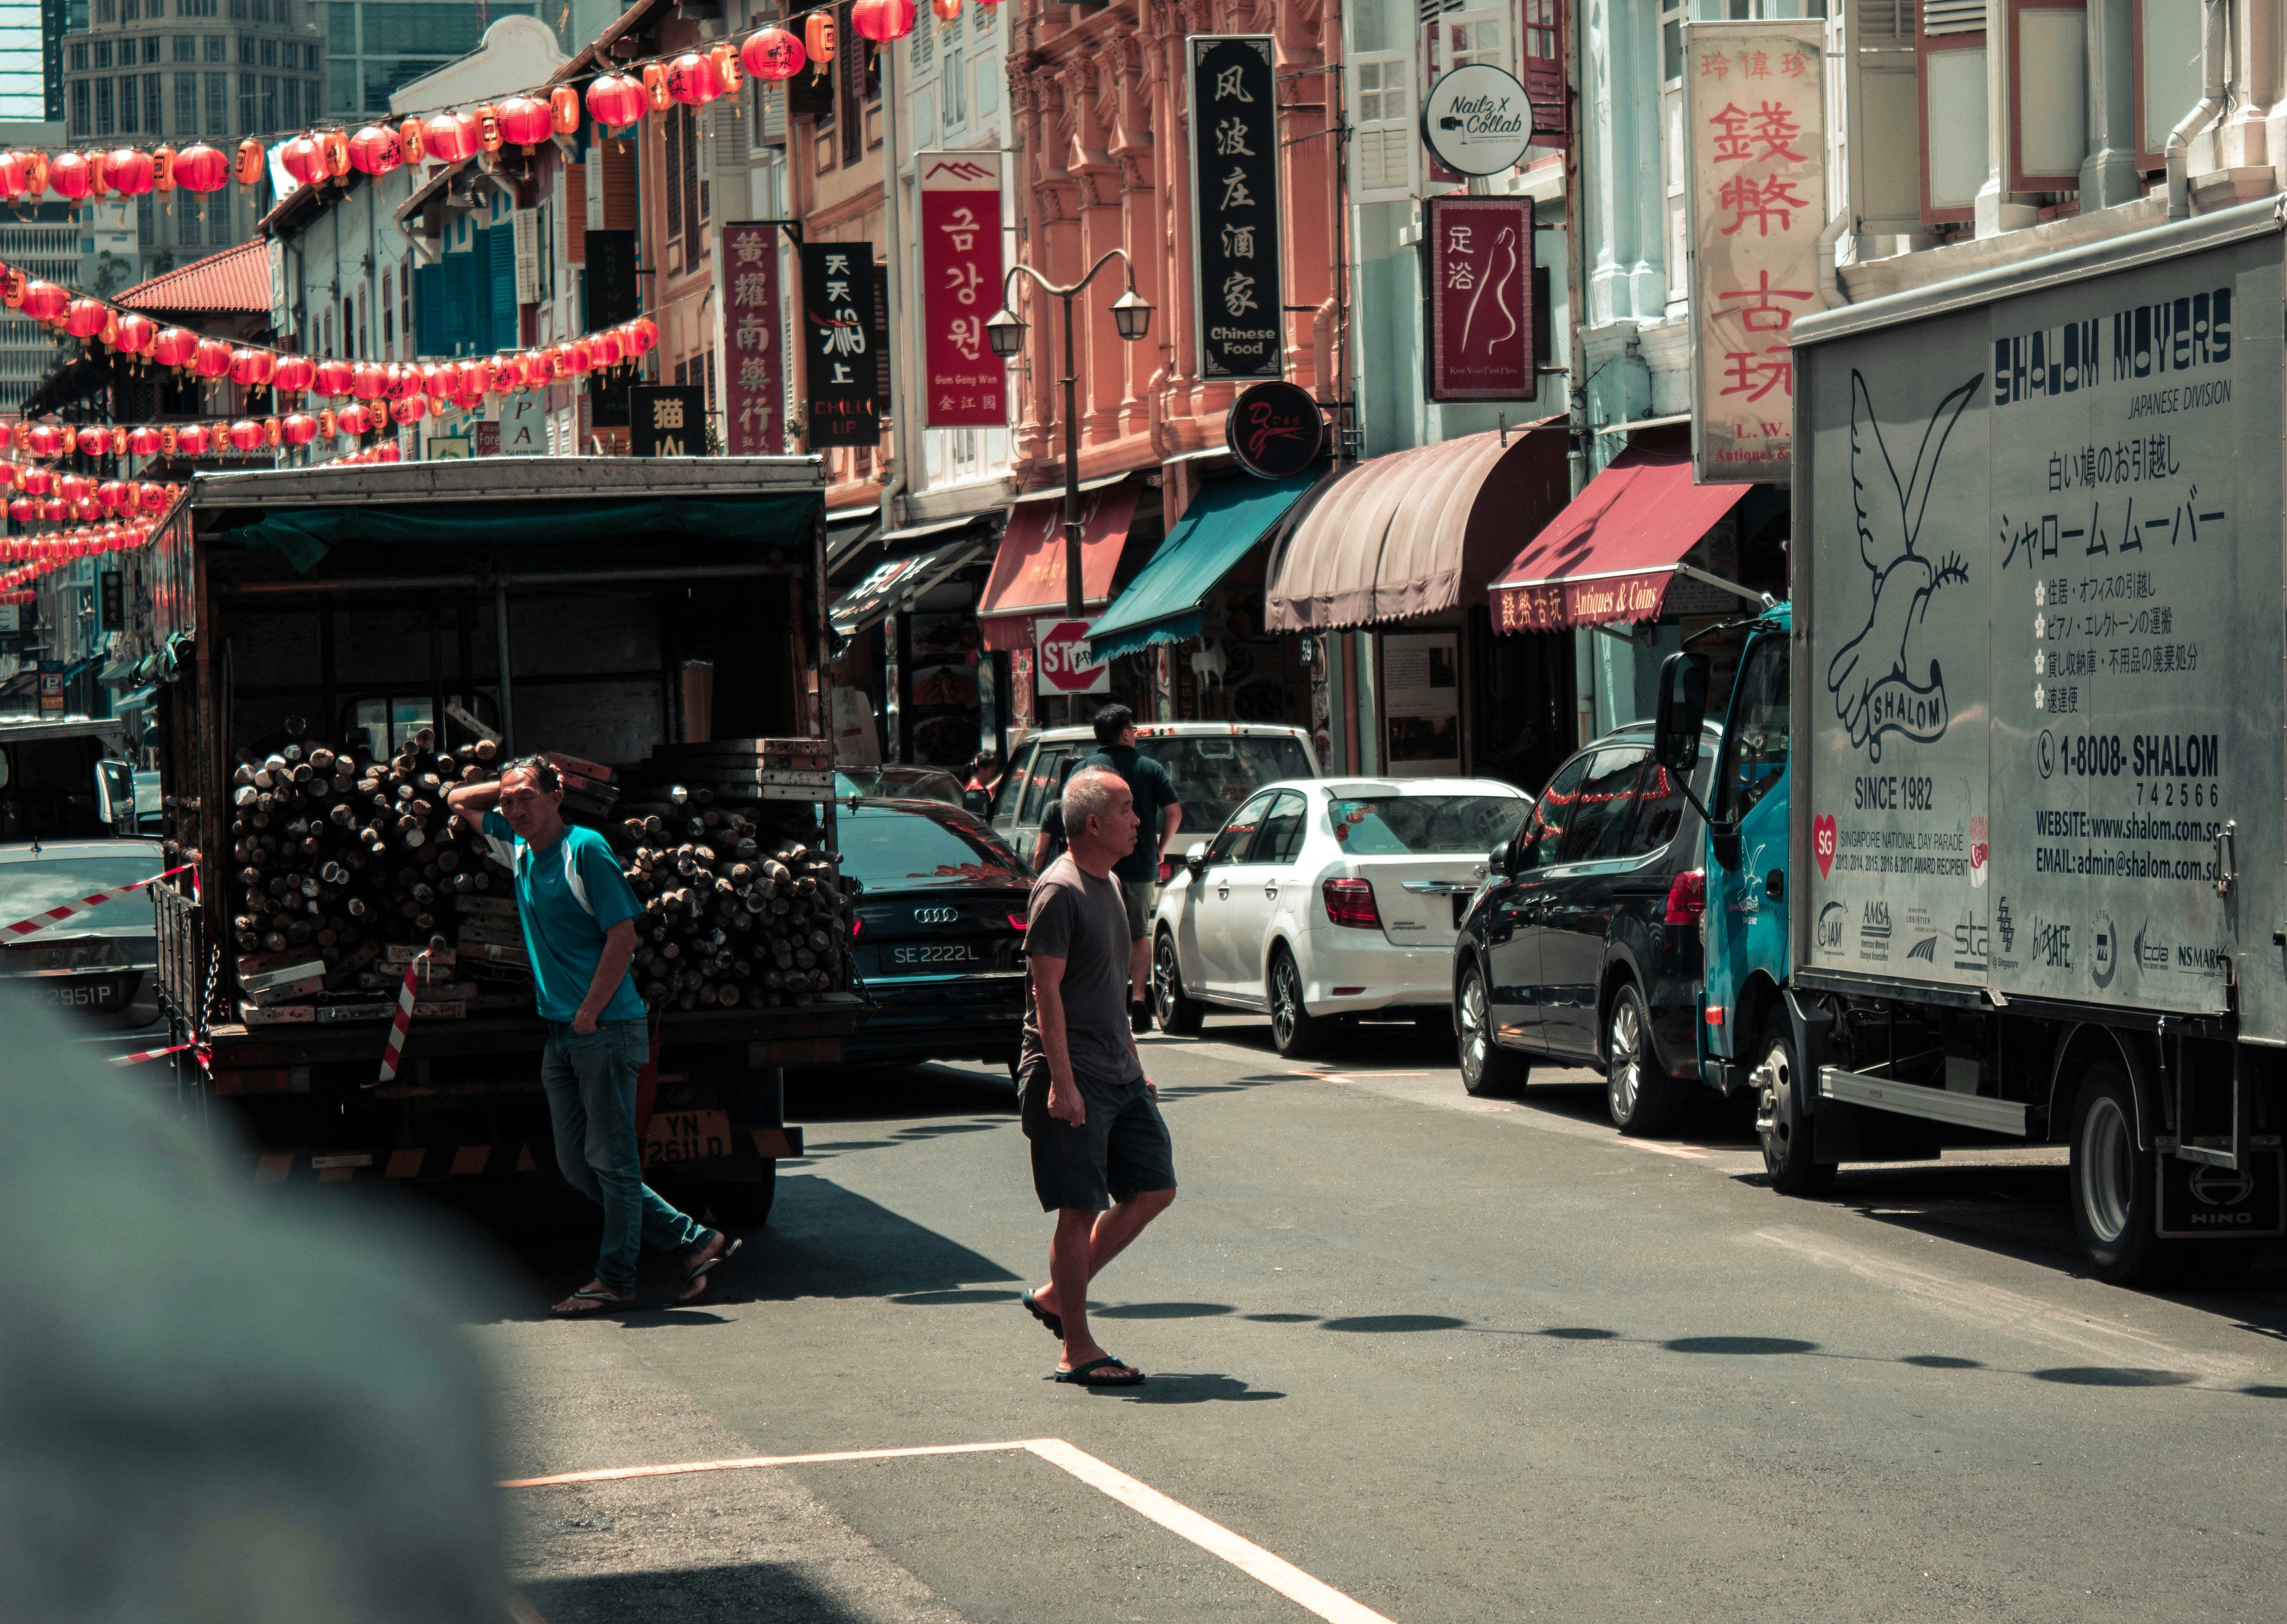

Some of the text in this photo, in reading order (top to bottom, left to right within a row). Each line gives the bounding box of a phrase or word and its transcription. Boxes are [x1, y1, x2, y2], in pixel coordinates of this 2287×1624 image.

[1450, 95, 1510, 121] Nailz X
[1467, 113, 1522, 133] Collab
[1215, 65, 1259, 318] 风波庄酒家
[1447, 226, 1475, 290] 足浴
[941, 207, 984, 361] 금강원
[1211, 327, 1276, 355] Chinese Food
[1995, 318, 2099, 406] SHALOM
[936, 375, 997, 386] Gum Gang Won
[939, 395, 996, 411] 金江园
[2129, 379, 2232, 420] JAPANESE DIVISION
[833, 421, 857, 435] UP
[1716, 446, 1788, 464] Antiques &
[2049, 432, 2180, 494] 白い鳩のお引越し
[2000, 484, 2225, 571] シャローム ムーバー
[1574, 584, 1614, 621] Antiques
[1616, 583, 1626, 612] &
[1629, 581, 1658, 611] Coins
[2047, 570, 2156, 607] 住居・オフィスの引越し
[2047, 605, 2172, 640] ピアノ・エレクトーンの運搬
[2047, 642, 2198, 679] 貸し収納庫・不用品の廃棄処分
[1873, 691, 1940, 731] SHALOM
[2047, 686, 2078, 714] 速達便
[2061, 734, 2218, 777] 1-8008- SHALOM
[1854, 776, 1932, 811] SINCE 1982
[2036, 811, 2090, 838] WEBSITE:
[1818, 830, 1832, 855] SG
[1840, 831, 1964, 851] SINGAPORE NATIONAL DAY PARADE
[1835, 854, 1969, 876] 2013, 2014, 2015, 2016 & 2017 AWARD RECIPIENT
[2036, 847, 2076, 874] EMAIL:
[1862, 900, 1889, 926] AMSA
[1906, 915, 1931, 925] LOGISTICS
[1828, 921, 1842, 948] IAM
[666, 1114, 699, 1137] YN
[2191, 1213, 2252, 1224] HINO
